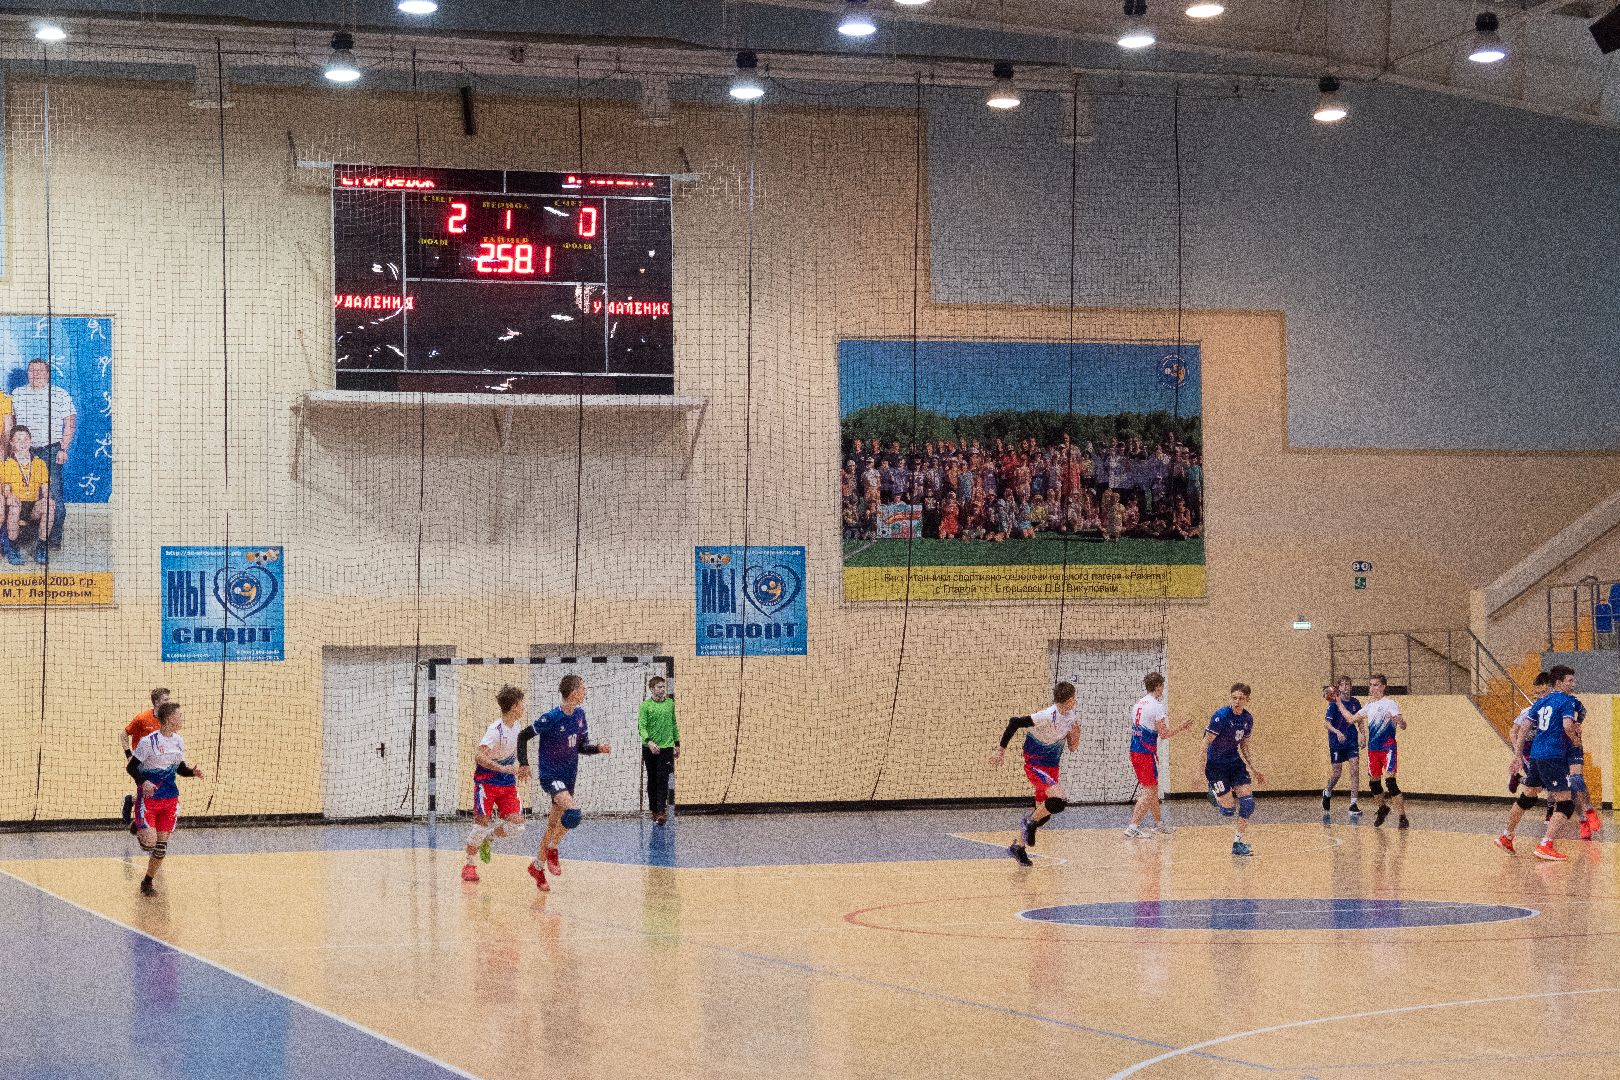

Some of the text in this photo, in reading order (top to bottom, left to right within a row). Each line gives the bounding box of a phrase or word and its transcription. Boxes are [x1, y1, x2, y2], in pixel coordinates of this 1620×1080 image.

[448, 203, 467, 233] 2
[506, 209, 512, 230] 1
[579, 207, 597, 237] 0
[334, 294, 414, 310] УДАЛЕНИЯ
[593, 301, 670, 315] УДАЛЕНИЯ
[50, 577, 75, 587] 2003
